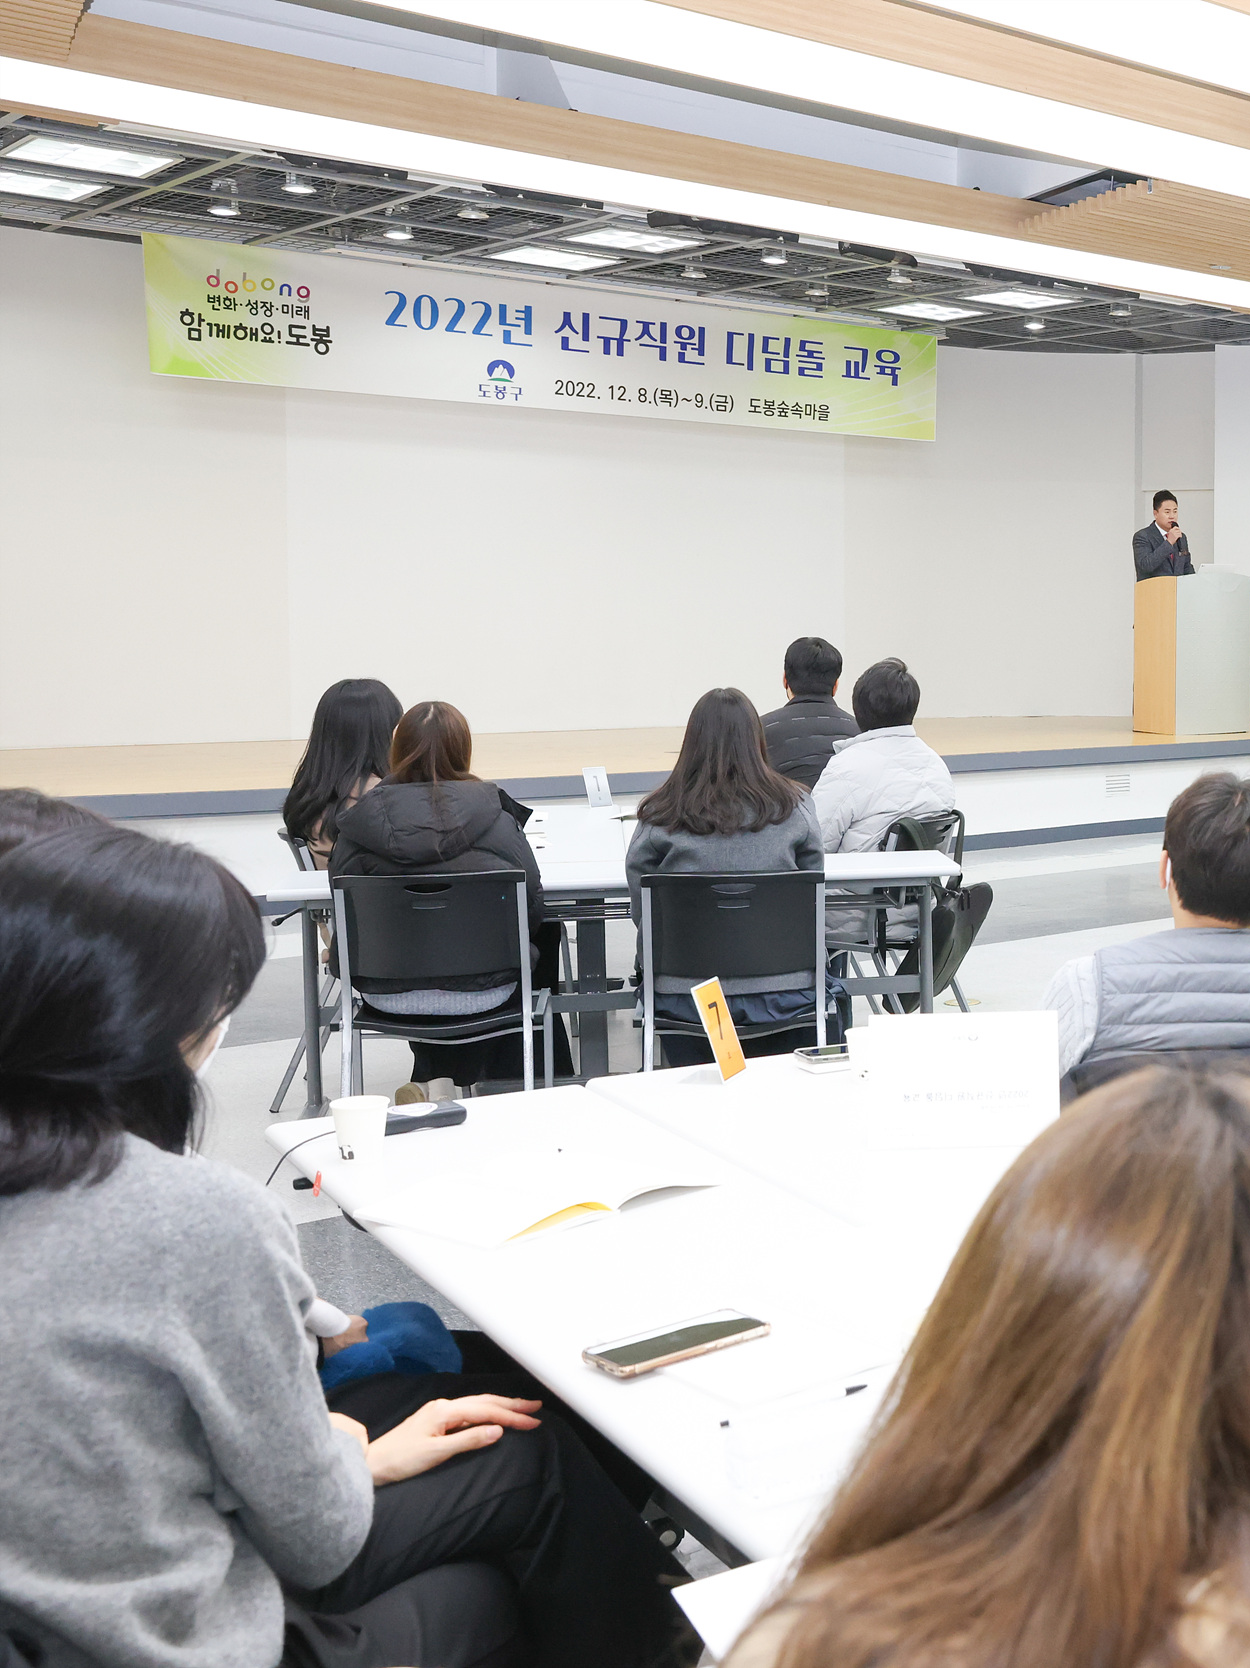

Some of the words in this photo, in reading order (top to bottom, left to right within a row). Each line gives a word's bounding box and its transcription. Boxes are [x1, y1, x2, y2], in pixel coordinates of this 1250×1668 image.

[206, 269, 311, 303] dobong
[385, 290, 533, 347] 2022년
[554, 311, 706, 366] 신규직원
[725, 331, 826, 379] 디딤돌
[841, 344, 902, 386] 교육
[478, 383, 523, 402] 도봉구
[554, 379, 601, 400] 2022.
[608, 385, 632, 402] 12.
[748, 397, 831, 421] 도봉숲속마을
[707, 1001, 723, 1040] 7
